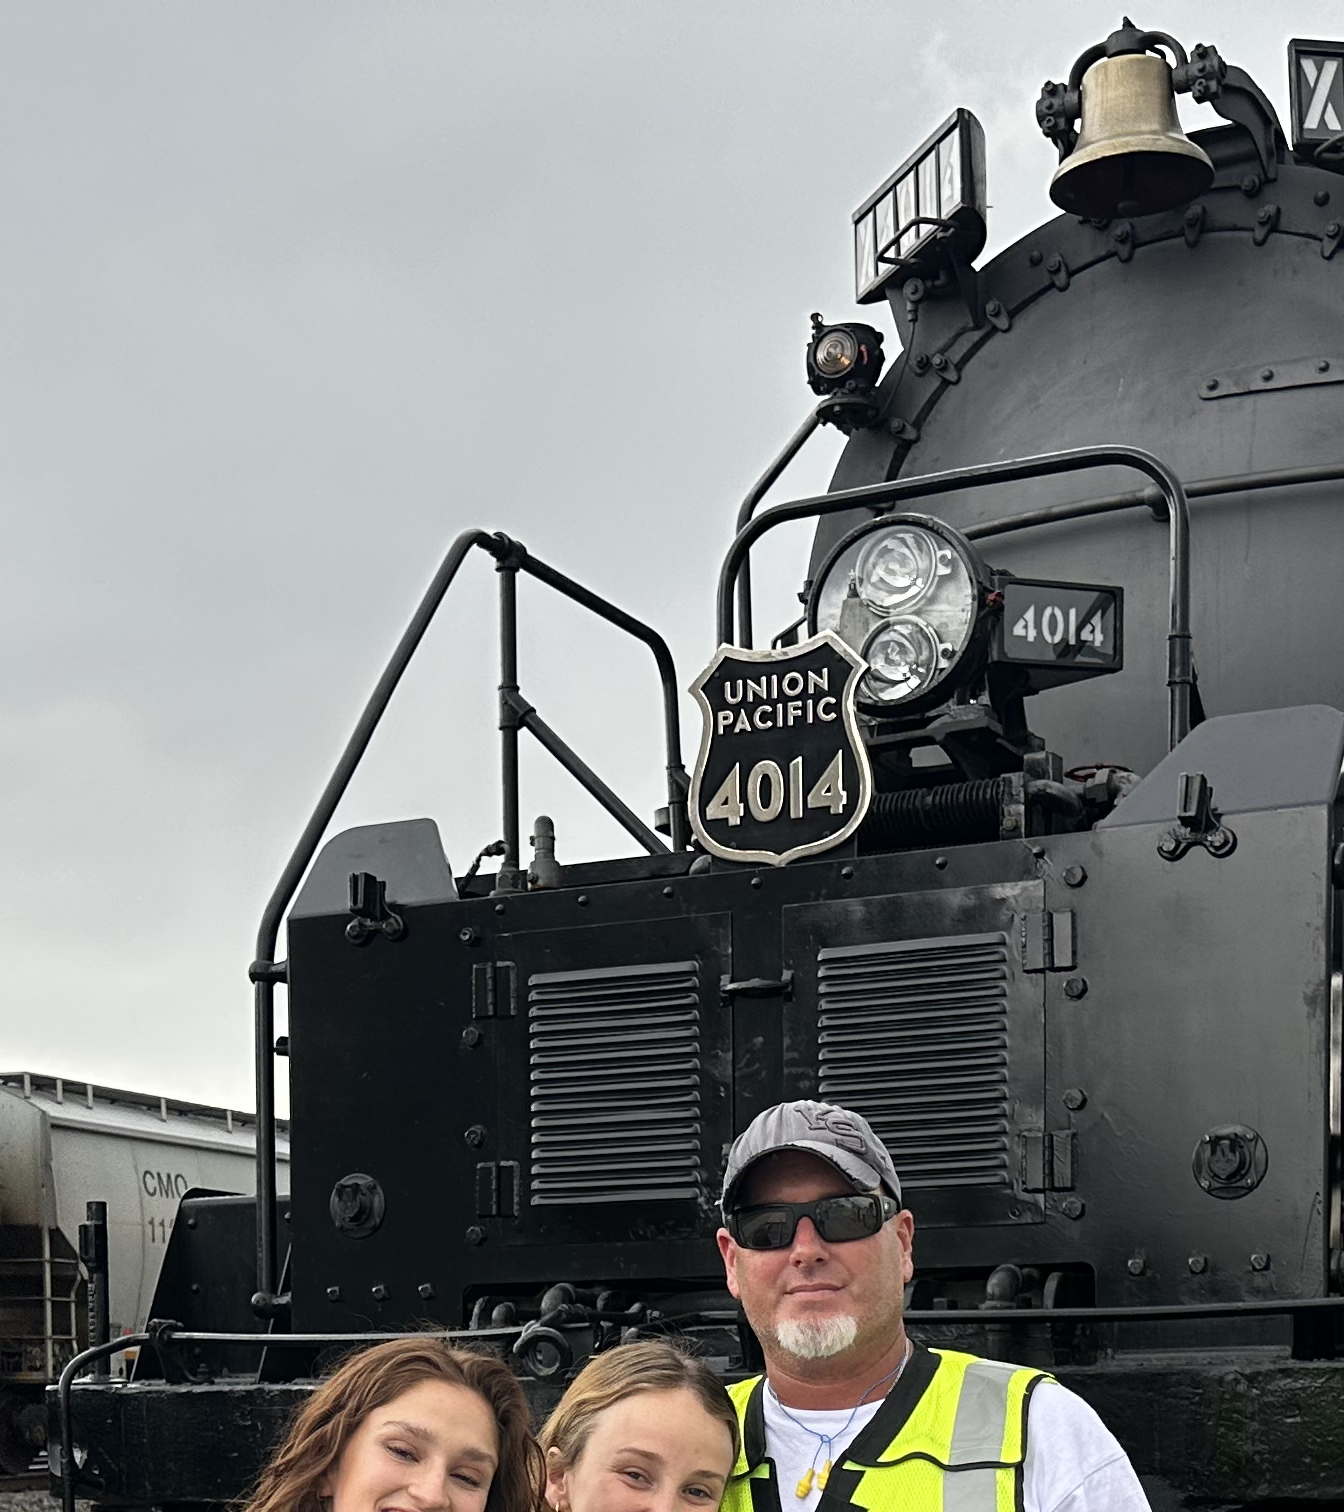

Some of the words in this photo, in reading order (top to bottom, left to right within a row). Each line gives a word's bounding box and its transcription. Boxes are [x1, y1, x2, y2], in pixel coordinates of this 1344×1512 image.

[1013, 603, 1104, 647] 4014
[724, 667, 829, 705] UNION
[717, 697, 838, 735] PACIFIC
[706, 749, 848, 826] 4014
[148, 1217, 175, 1244] 11
